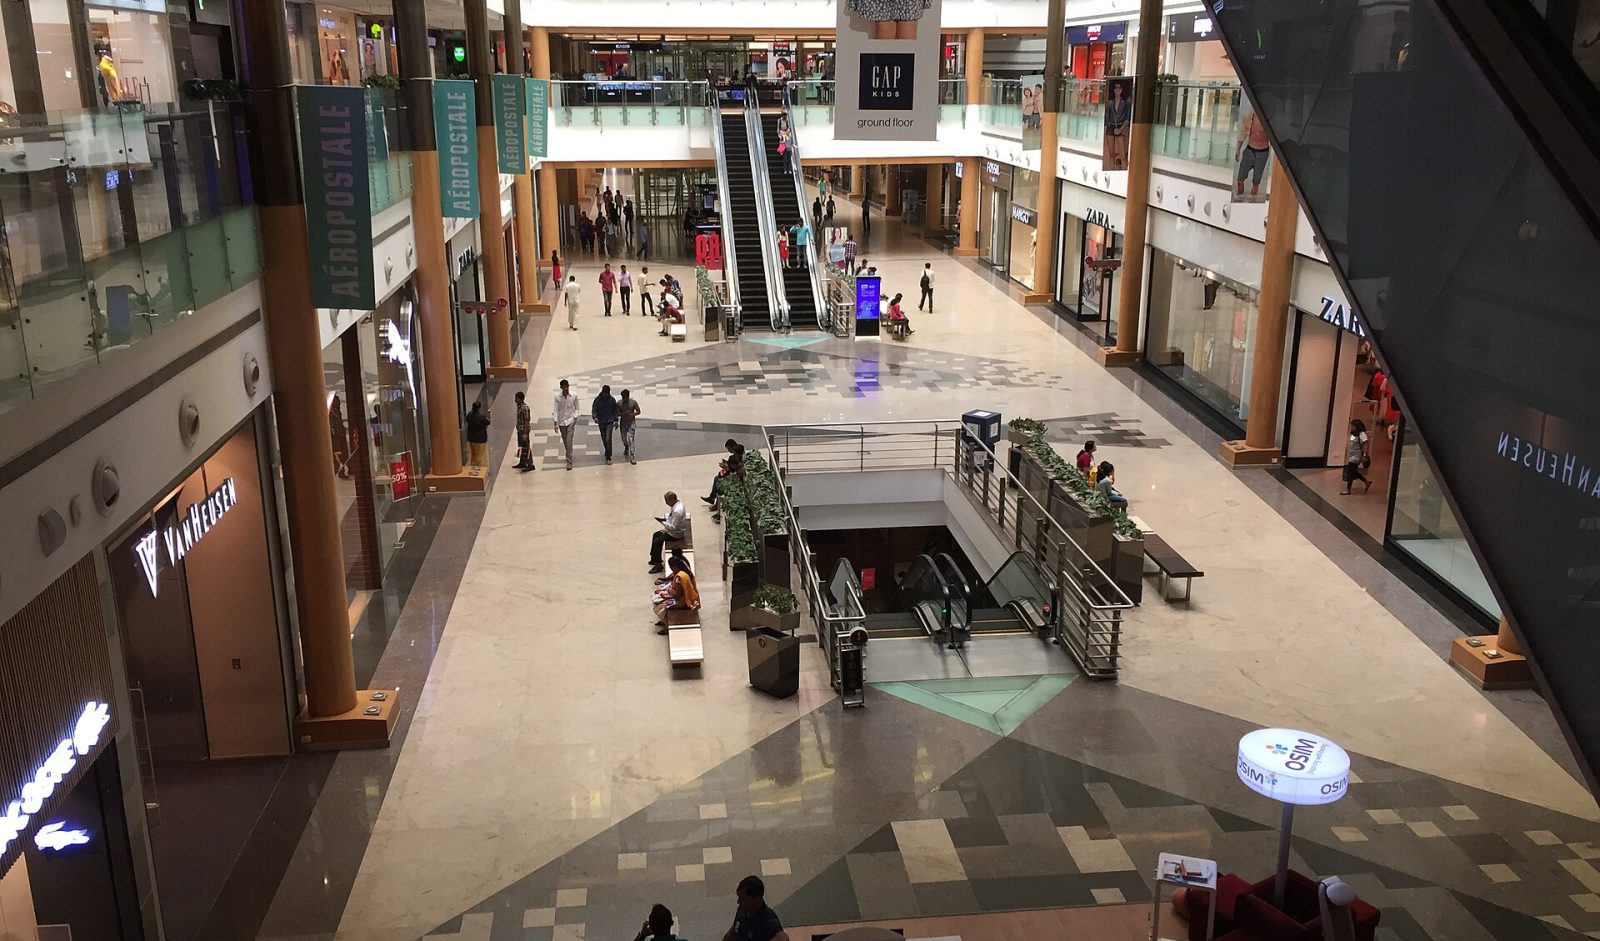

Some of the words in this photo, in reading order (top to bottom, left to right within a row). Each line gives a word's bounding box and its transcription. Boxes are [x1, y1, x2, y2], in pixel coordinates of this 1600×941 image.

[872, 65, 901, 88] GAP
[502, 82, 519, 169] AÉROPOSTALE
[530, 85, 544, 153] AÉROPOSTALE
[857, 118, 891, 128] ground
[892, 118, 914, 127] floor
[447, 92, 471, 211] AÉROPOSTALE
[319, 104, 361, 299] AÉROPOSTALE
[1012, 206, 1030, 224] MANGO
[1086, 207, 1110, 230] ZARA
[1285, 738, 1317, 771] OSIM
